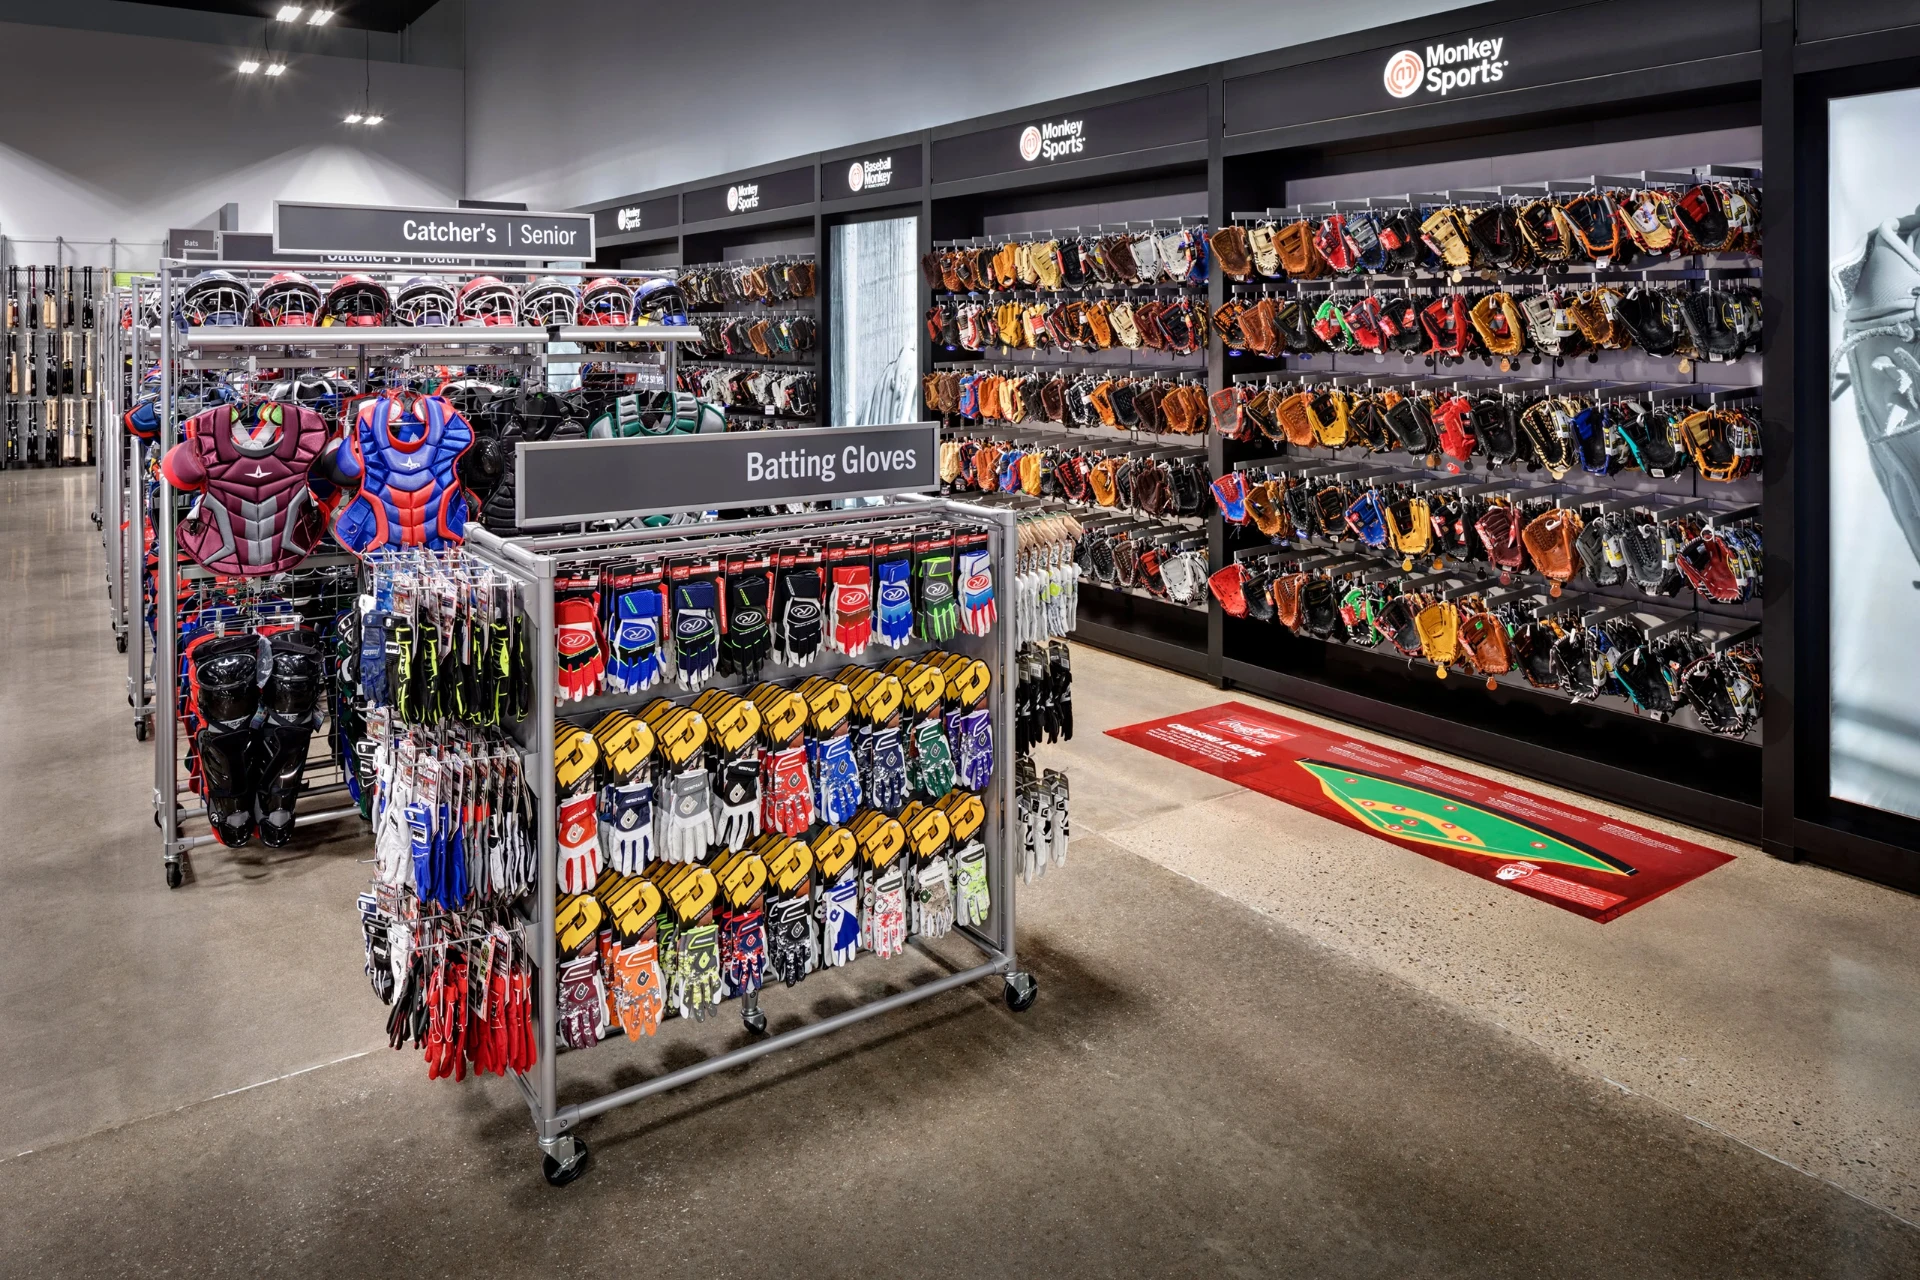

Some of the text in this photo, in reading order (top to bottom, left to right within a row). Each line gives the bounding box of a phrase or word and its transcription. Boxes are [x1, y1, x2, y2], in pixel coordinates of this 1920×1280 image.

[1426, 37, 1503, 68] Monkey
[1426, 60, 1505, 96] Sports
[1042, 119, 1083, 140] Monkey
[1042, 135, 1084, 161] Sports
[864, 156, 891, 173] Baseball
[864, 170, 892, 185] Monkey
[738, 183, 758, 199] Monkey
[738, 194, 758, 212] Sports
[403, 219, 577, 246] Catcher's Senior
[187, 241, 204, 250] Bats
[327, 255, 401, 263] atchers
[747, 445, 916, 482] Batting Gloves
